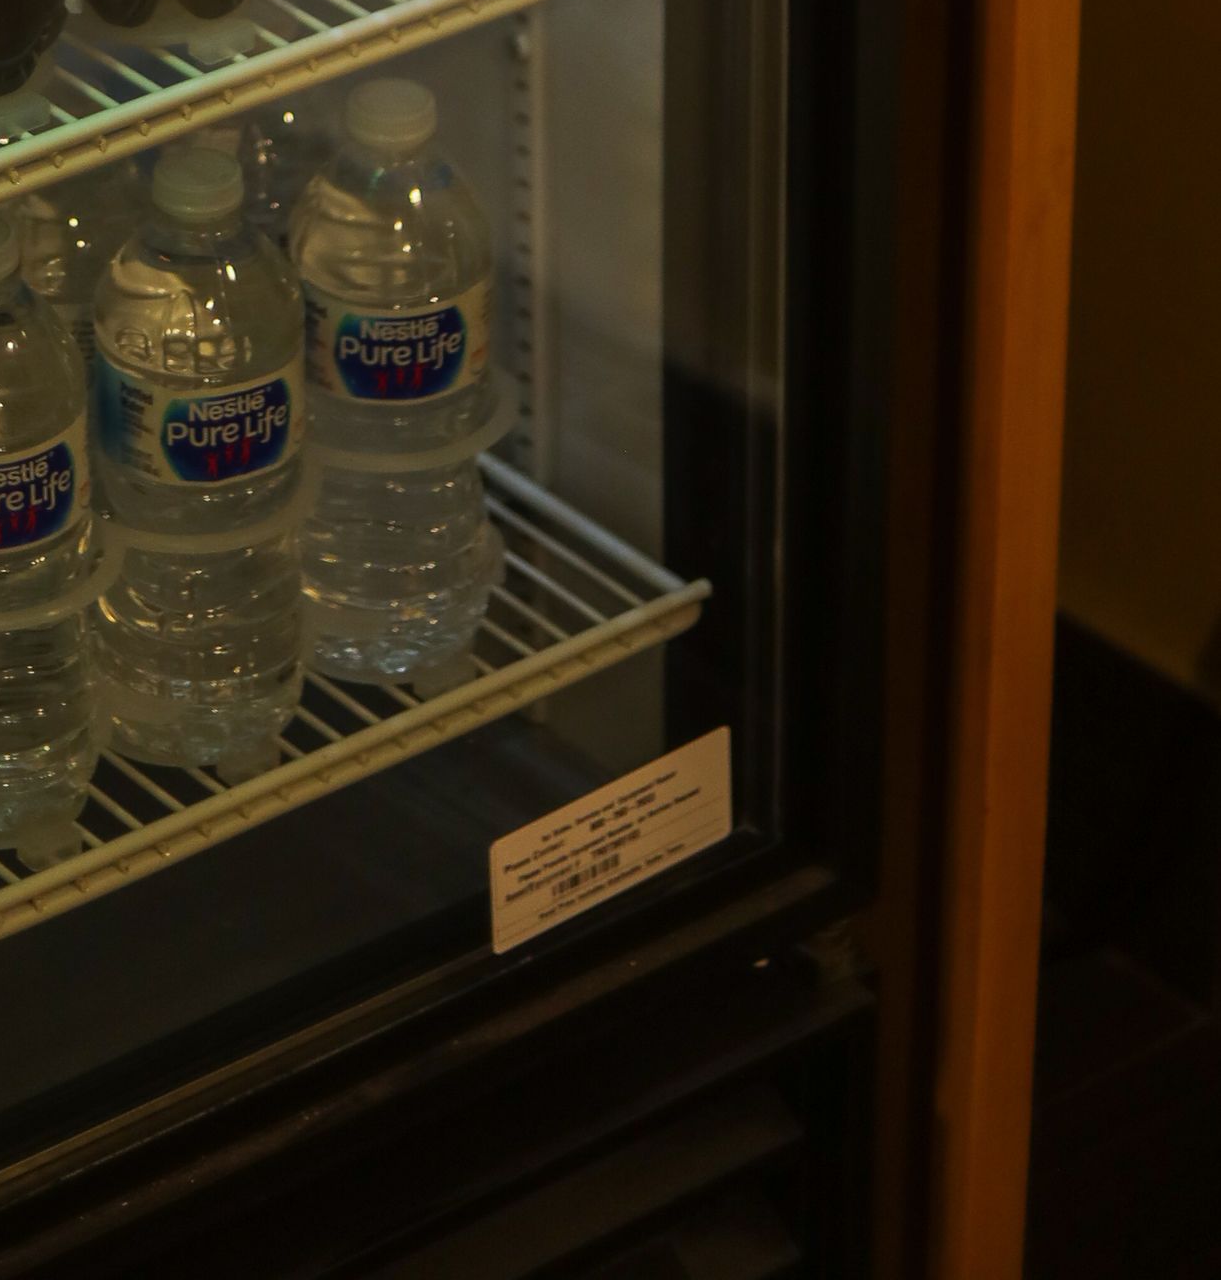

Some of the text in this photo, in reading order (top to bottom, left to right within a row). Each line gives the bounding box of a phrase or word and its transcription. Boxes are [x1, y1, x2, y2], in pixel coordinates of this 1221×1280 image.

[340, 332, 462, 370] Pure Life
[167, 422, 239, 447] Pure
[246, 404, 287, 443] Life
[30, 470, 71, 511] Life
